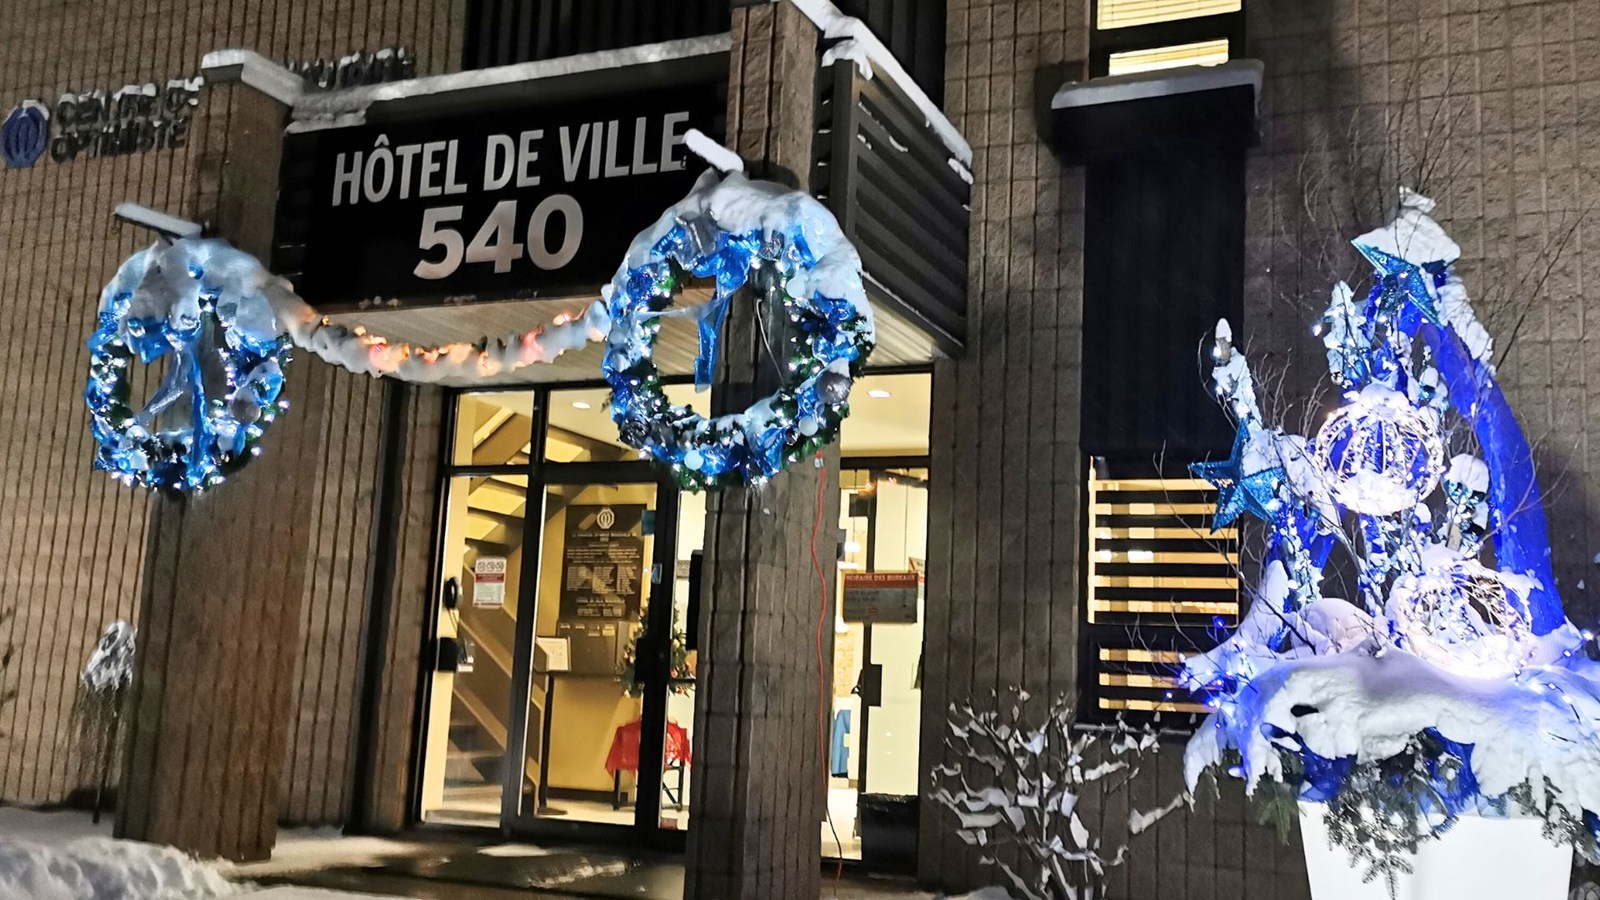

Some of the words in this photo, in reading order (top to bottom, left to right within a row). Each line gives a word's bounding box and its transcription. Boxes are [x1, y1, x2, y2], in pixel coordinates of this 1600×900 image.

[332, 133, 468, 207] HÔTEL
[483, 128, 544, 191] DE
[559, 111, 690, 182] VILLE
[413, 193, 584, 280] 540
